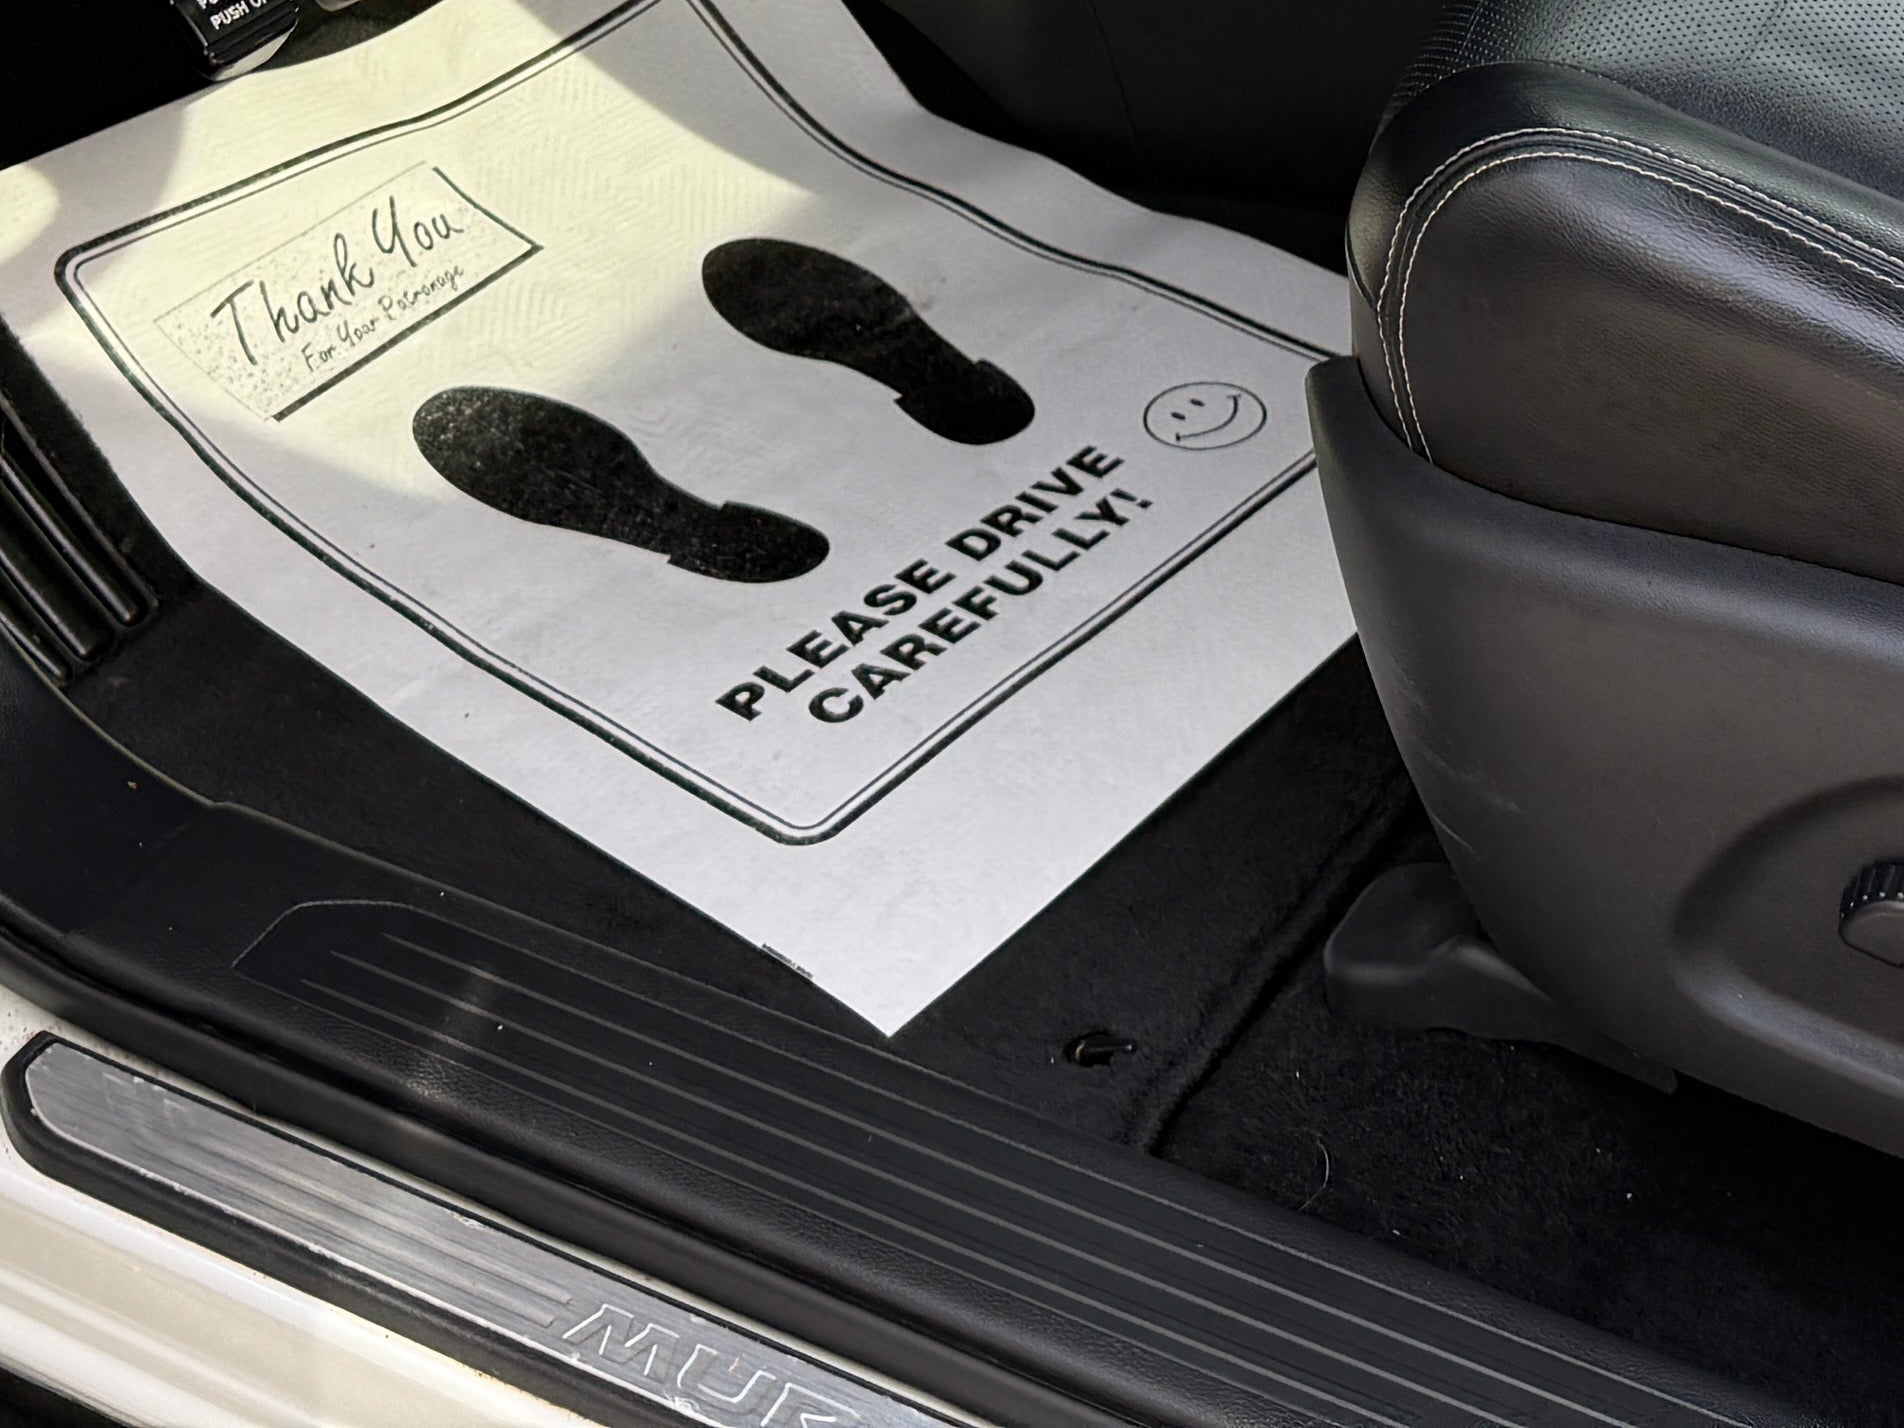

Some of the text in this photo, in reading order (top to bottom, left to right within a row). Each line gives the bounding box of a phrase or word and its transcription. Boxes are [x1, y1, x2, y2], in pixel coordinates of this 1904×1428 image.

[209, 0, 250, 31] PUSH
[210, 194, 465, 366] Thank You
[300, 341, 338, 373] For
[336, 316, 381, 348] Your
[714, 444, 1126, 722] PLEASE DRIVE
[807, 487, 1154, 724] CAREFULLY!
